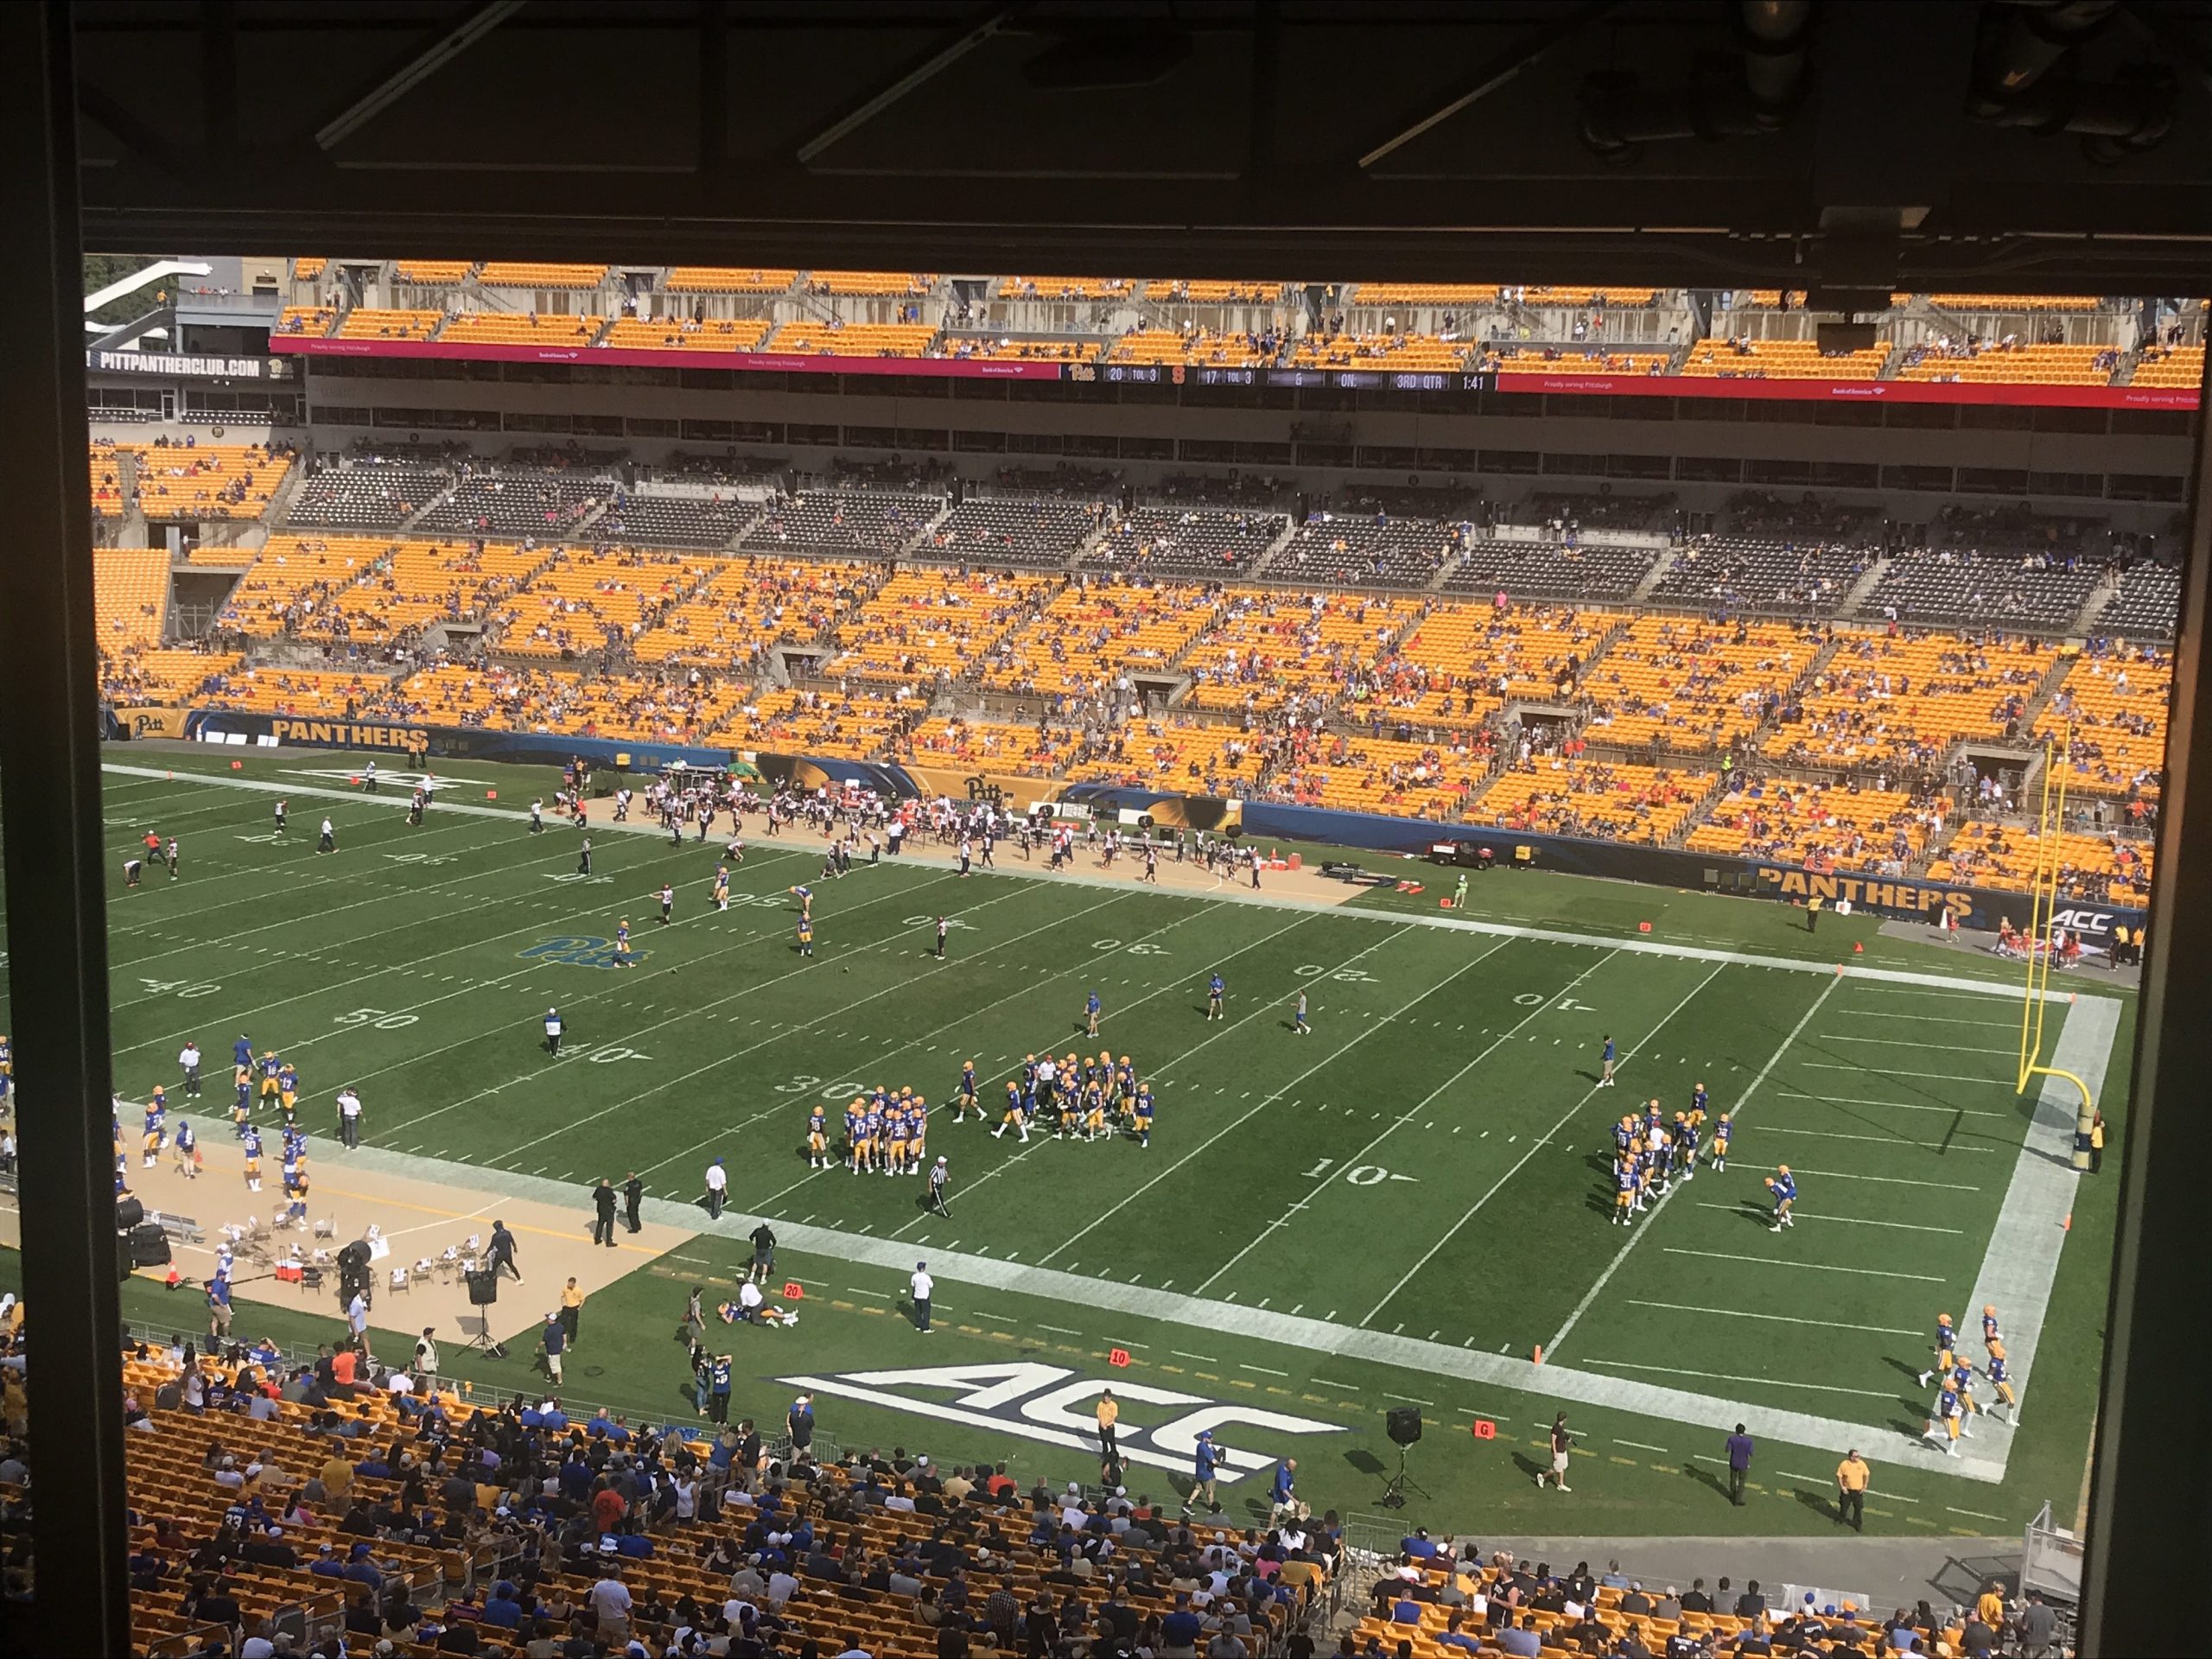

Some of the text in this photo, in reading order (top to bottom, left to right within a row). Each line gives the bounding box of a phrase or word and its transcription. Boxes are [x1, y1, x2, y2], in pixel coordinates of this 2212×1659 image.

[100, 353, 259, 377] PITTPANTHERCLUB.COM
[1068, 363, 1096, 382] Pitt
[1110, 368, 1157, 382] 20 TOL 3
[1172, 365, 1185, 385] S
[1206, 371, 1252, 385] 17 TOL 3
[1295, 372, 1302, 386] &
[1397, 374, 1442, 389] 3RD QTR
[1463, 376, 1484, 390] 1:41
[134, 715, 165, 732] Pitt
[272, 720, 429, 748] PANTHERS
[963, 776, 1001, 801] Pitt
[2049, 909, 2113, 931] ACC
[334, 1007, 420, 1029] 50
[774, 1075, 864, 1100] 30
[855, 1122, 867, 1134] 47
[1300, 1158, 1389, 1185] 10
[785, 1285, 798, 1296] 20
[1112, 1351, 1126, 1363] 10
[835, 1361, 1350, 1471] ACC
[1480, 1423, 1489, 1436] G
